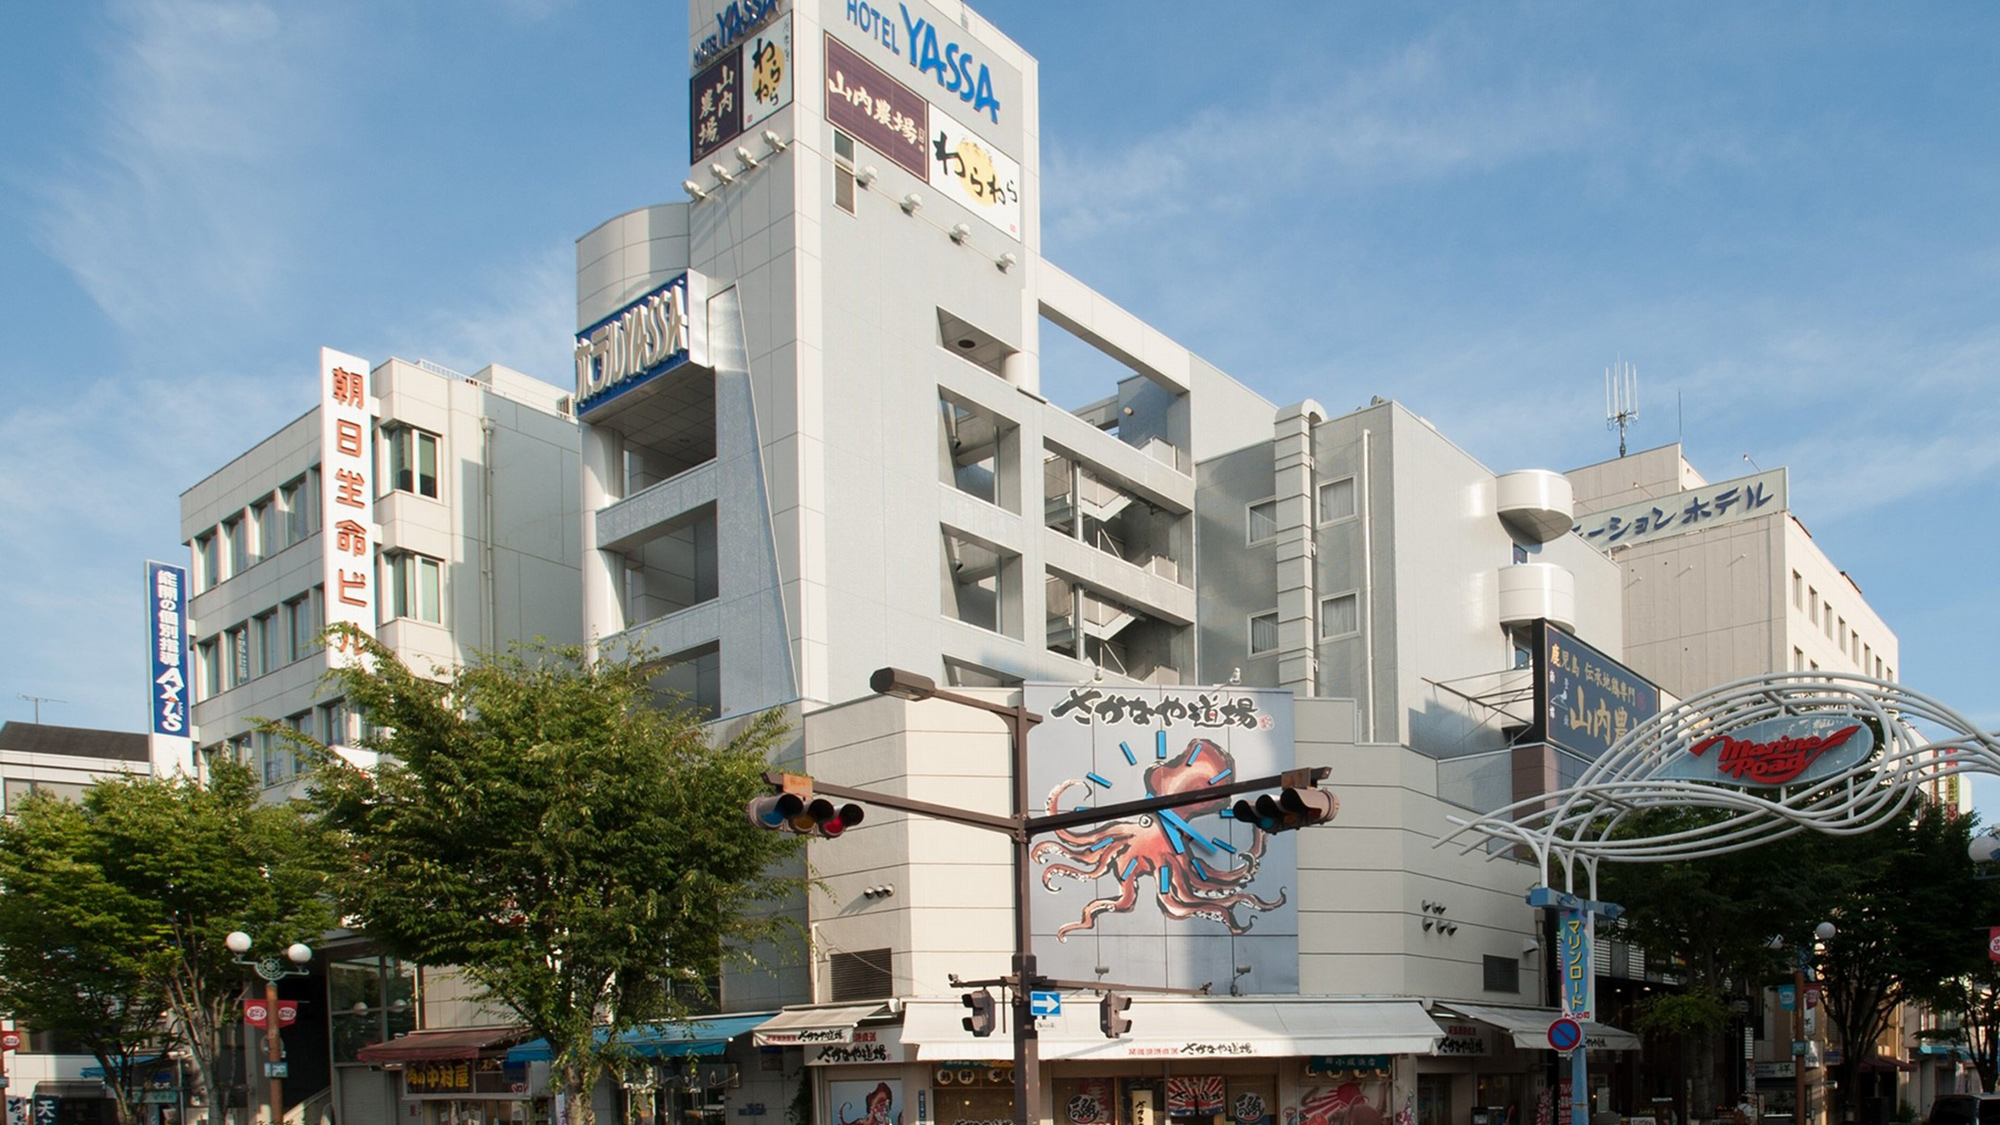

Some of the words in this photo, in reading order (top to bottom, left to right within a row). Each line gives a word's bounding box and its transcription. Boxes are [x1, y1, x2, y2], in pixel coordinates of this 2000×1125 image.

[846, 0, 901, 55] HOTEL
[900, 4, 1001, 125] YASSA
[828, 70, 918, 145] 山内農場
[932, 130, 1018, 206] わらわら
[1051, 688, 1258, 730] さかなや道場
[1690, 733, 1832, 762] Marine
[1718, 753, 1812, 785] Road
[1567, 920, 1584, 1011] マリンロード
[817, 1044, 887, 1063] さかなや道場
